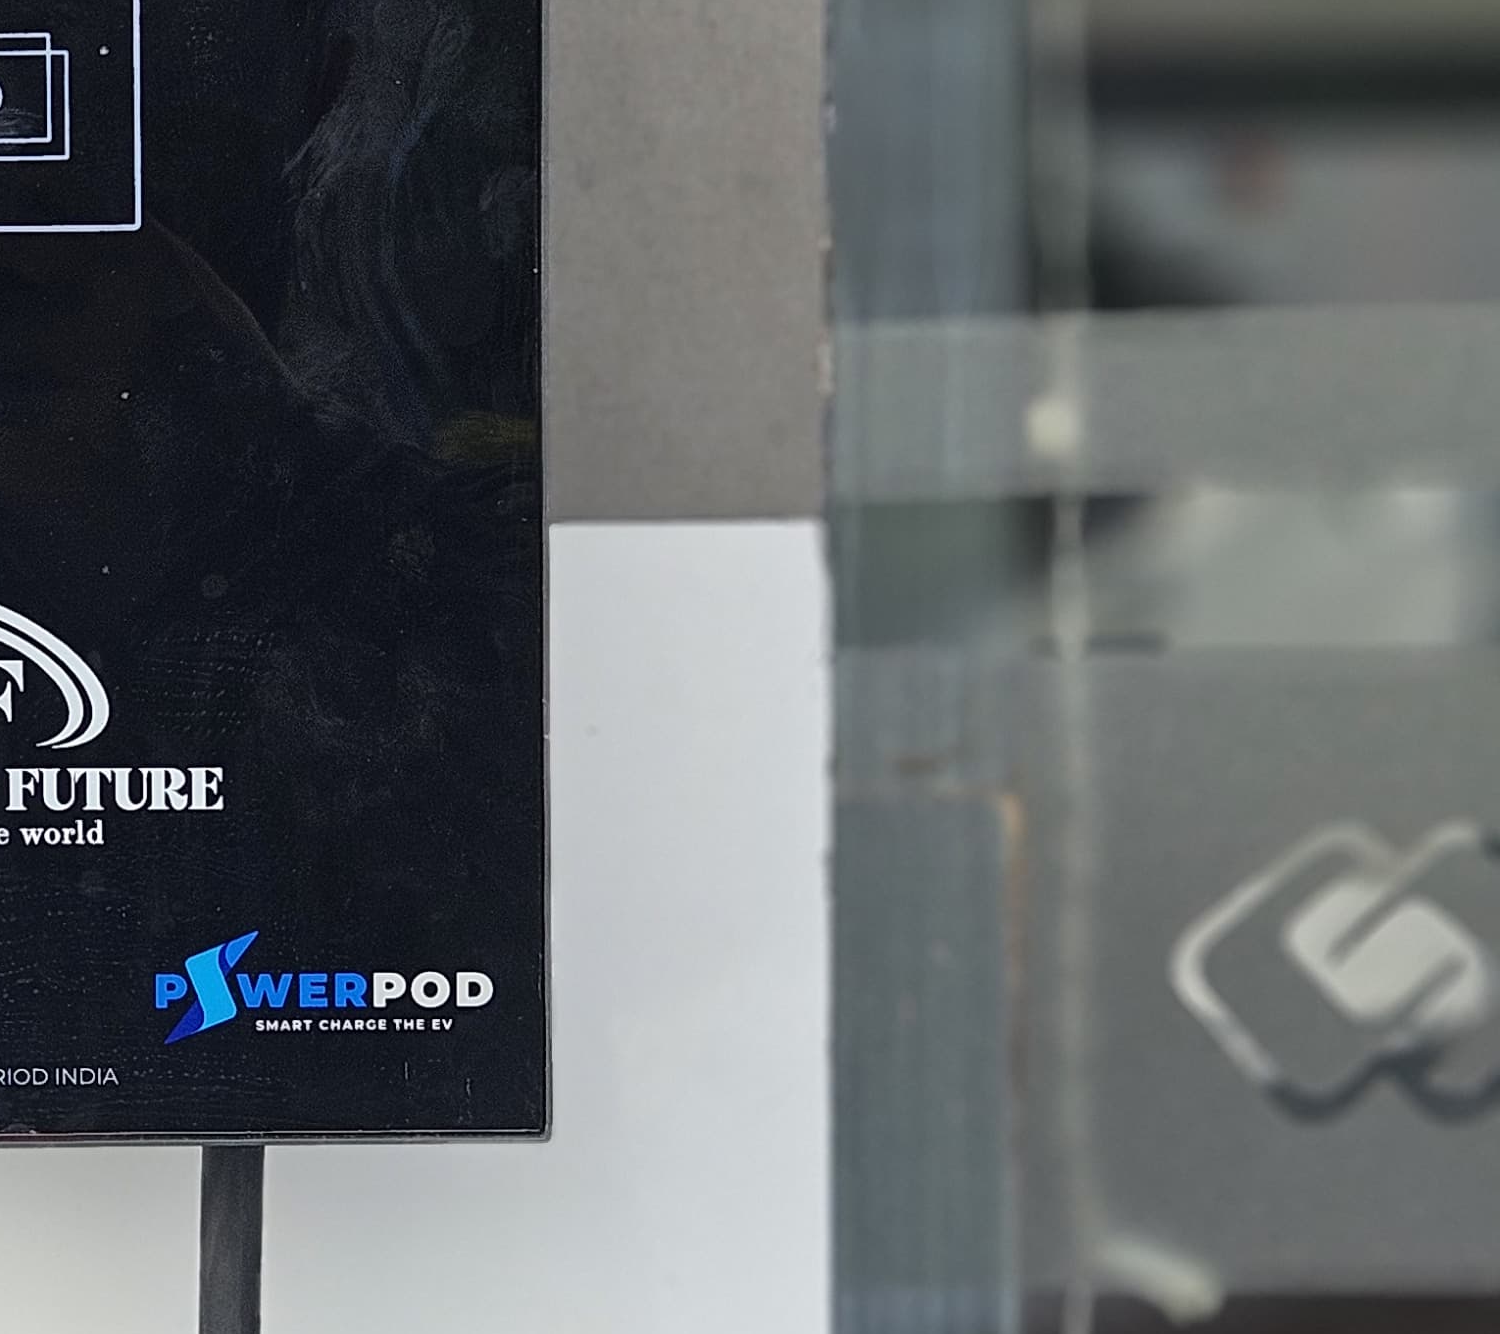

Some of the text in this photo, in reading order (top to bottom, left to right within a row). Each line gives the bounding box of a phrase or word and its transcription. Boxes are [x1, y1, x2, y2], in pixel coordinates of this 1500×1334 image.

[4, 767, 225, 811] FUTURE
[20, 818, 105, 845] world
[255, 1018, 453, 1032] SMART CHARGE THE EV
[55, 1067, 120, 1085] INDIA
